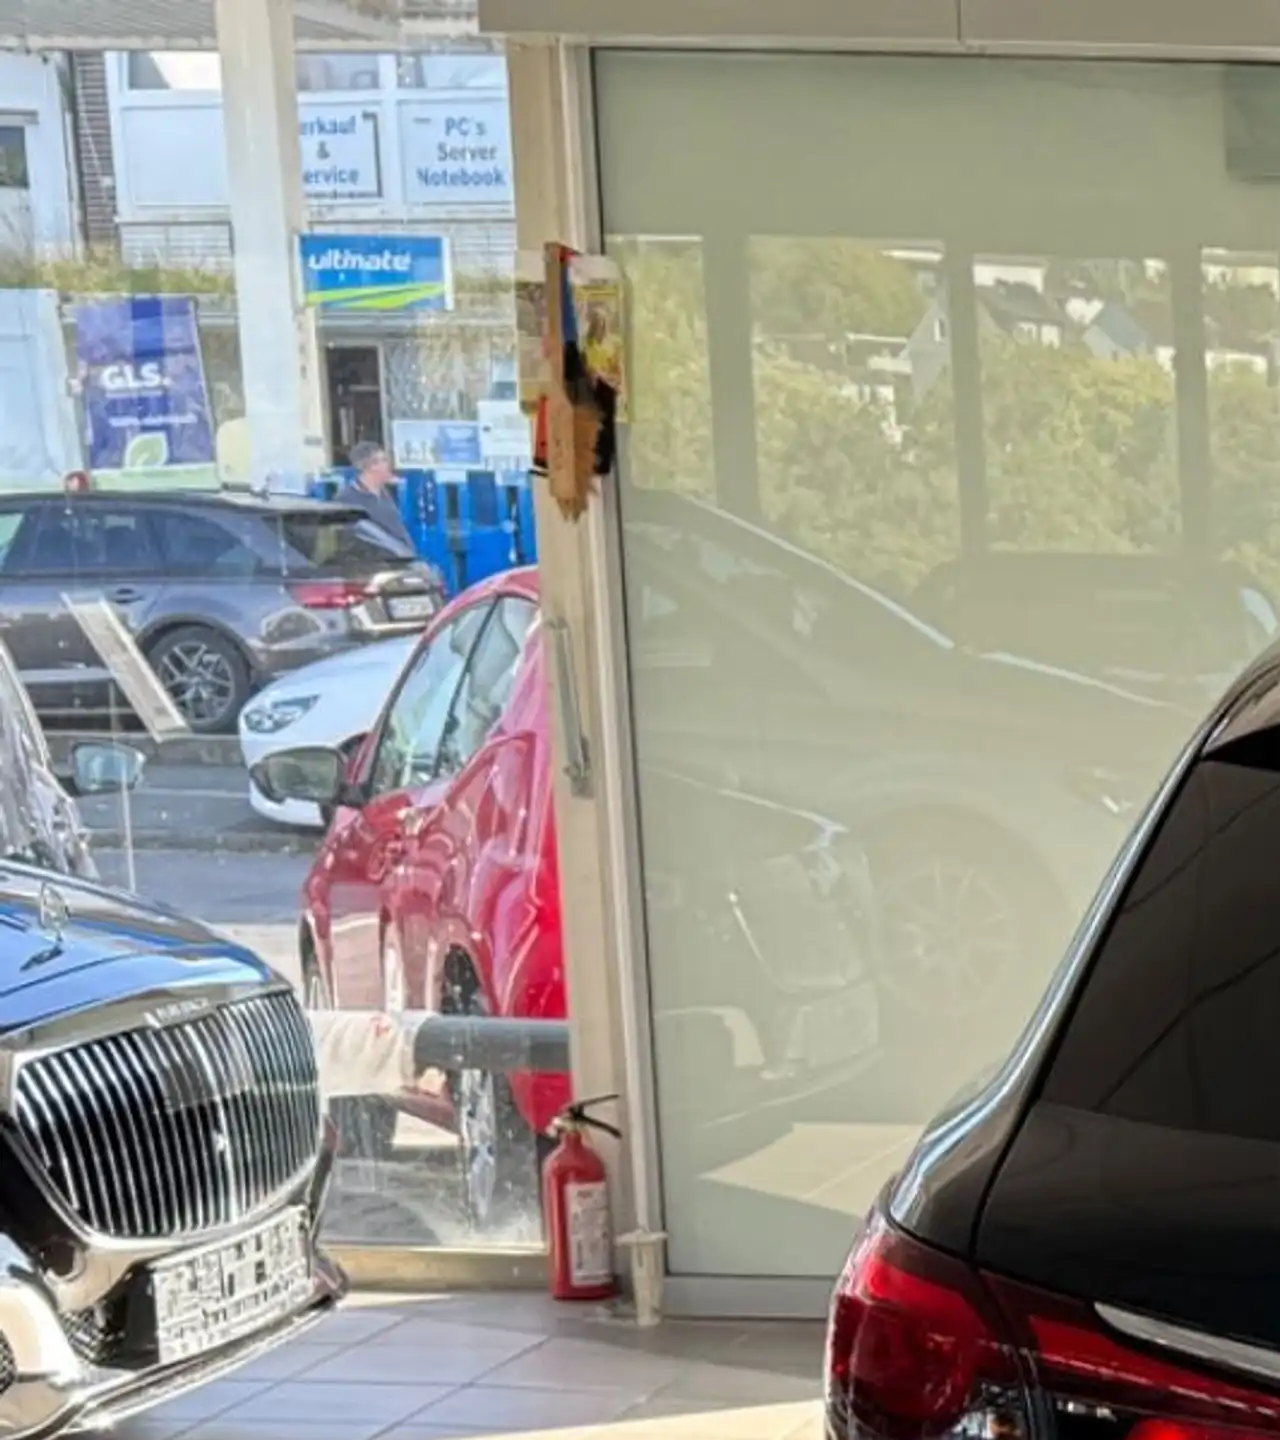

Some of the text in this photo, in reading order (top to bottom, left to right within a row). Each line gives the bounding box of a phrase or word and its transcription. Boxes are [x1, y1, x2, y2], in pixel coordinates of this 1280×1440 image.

[298, 116, 357, 135] erkauf
[316, 142, 330, 159] &
[437, 142, 497, 162] Server
[303, 165, 359, 185] ervice
[416, 165, 507, 187] Notebook
[308, 250, 412, 272] ultimate
